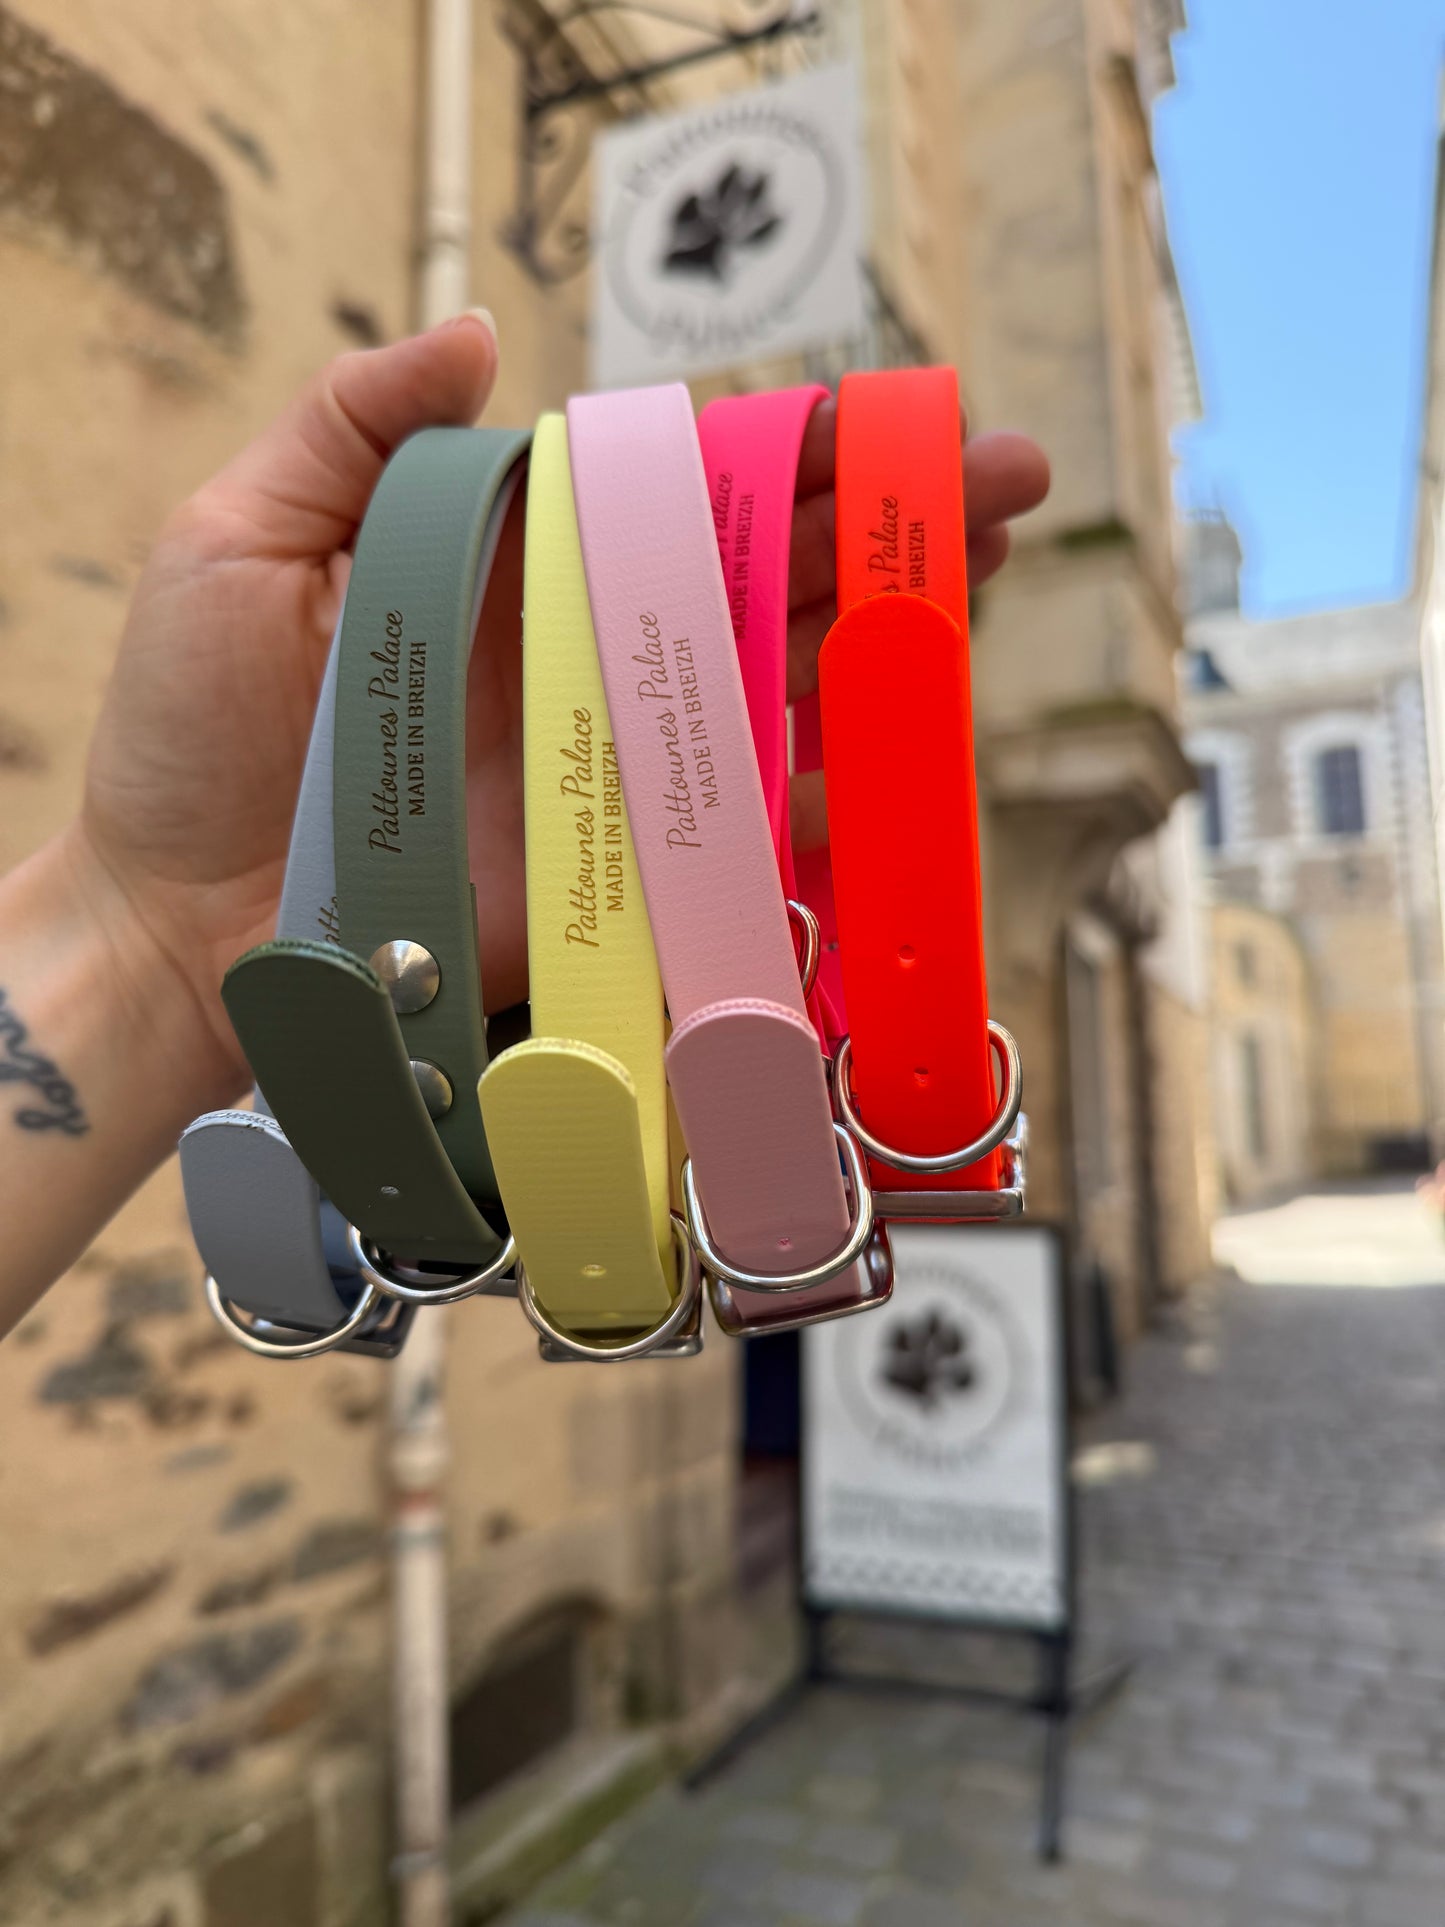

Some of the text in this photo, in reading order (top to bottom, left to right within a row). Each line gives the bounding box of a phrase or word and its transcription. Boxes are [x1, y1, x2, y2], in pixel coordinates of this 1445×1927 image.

[731, 494, 755, 640] MADE IN BREIZH
[867, 495, 900, 574] Palace
[908, 520, 926, 588] BREIZH
[368, 609, 404, 854] Pattounes Palace
[408, 641, 427, 816] MADE IN BREIZH
[632, 611, 702, 850] Pattounes Palace
[673, 637, 721, 809] MADE IN BREIZH
[560, 706, 600, 948] Pattounes Palace
[602, 741, 625, 912] MADE IN BREIZH
